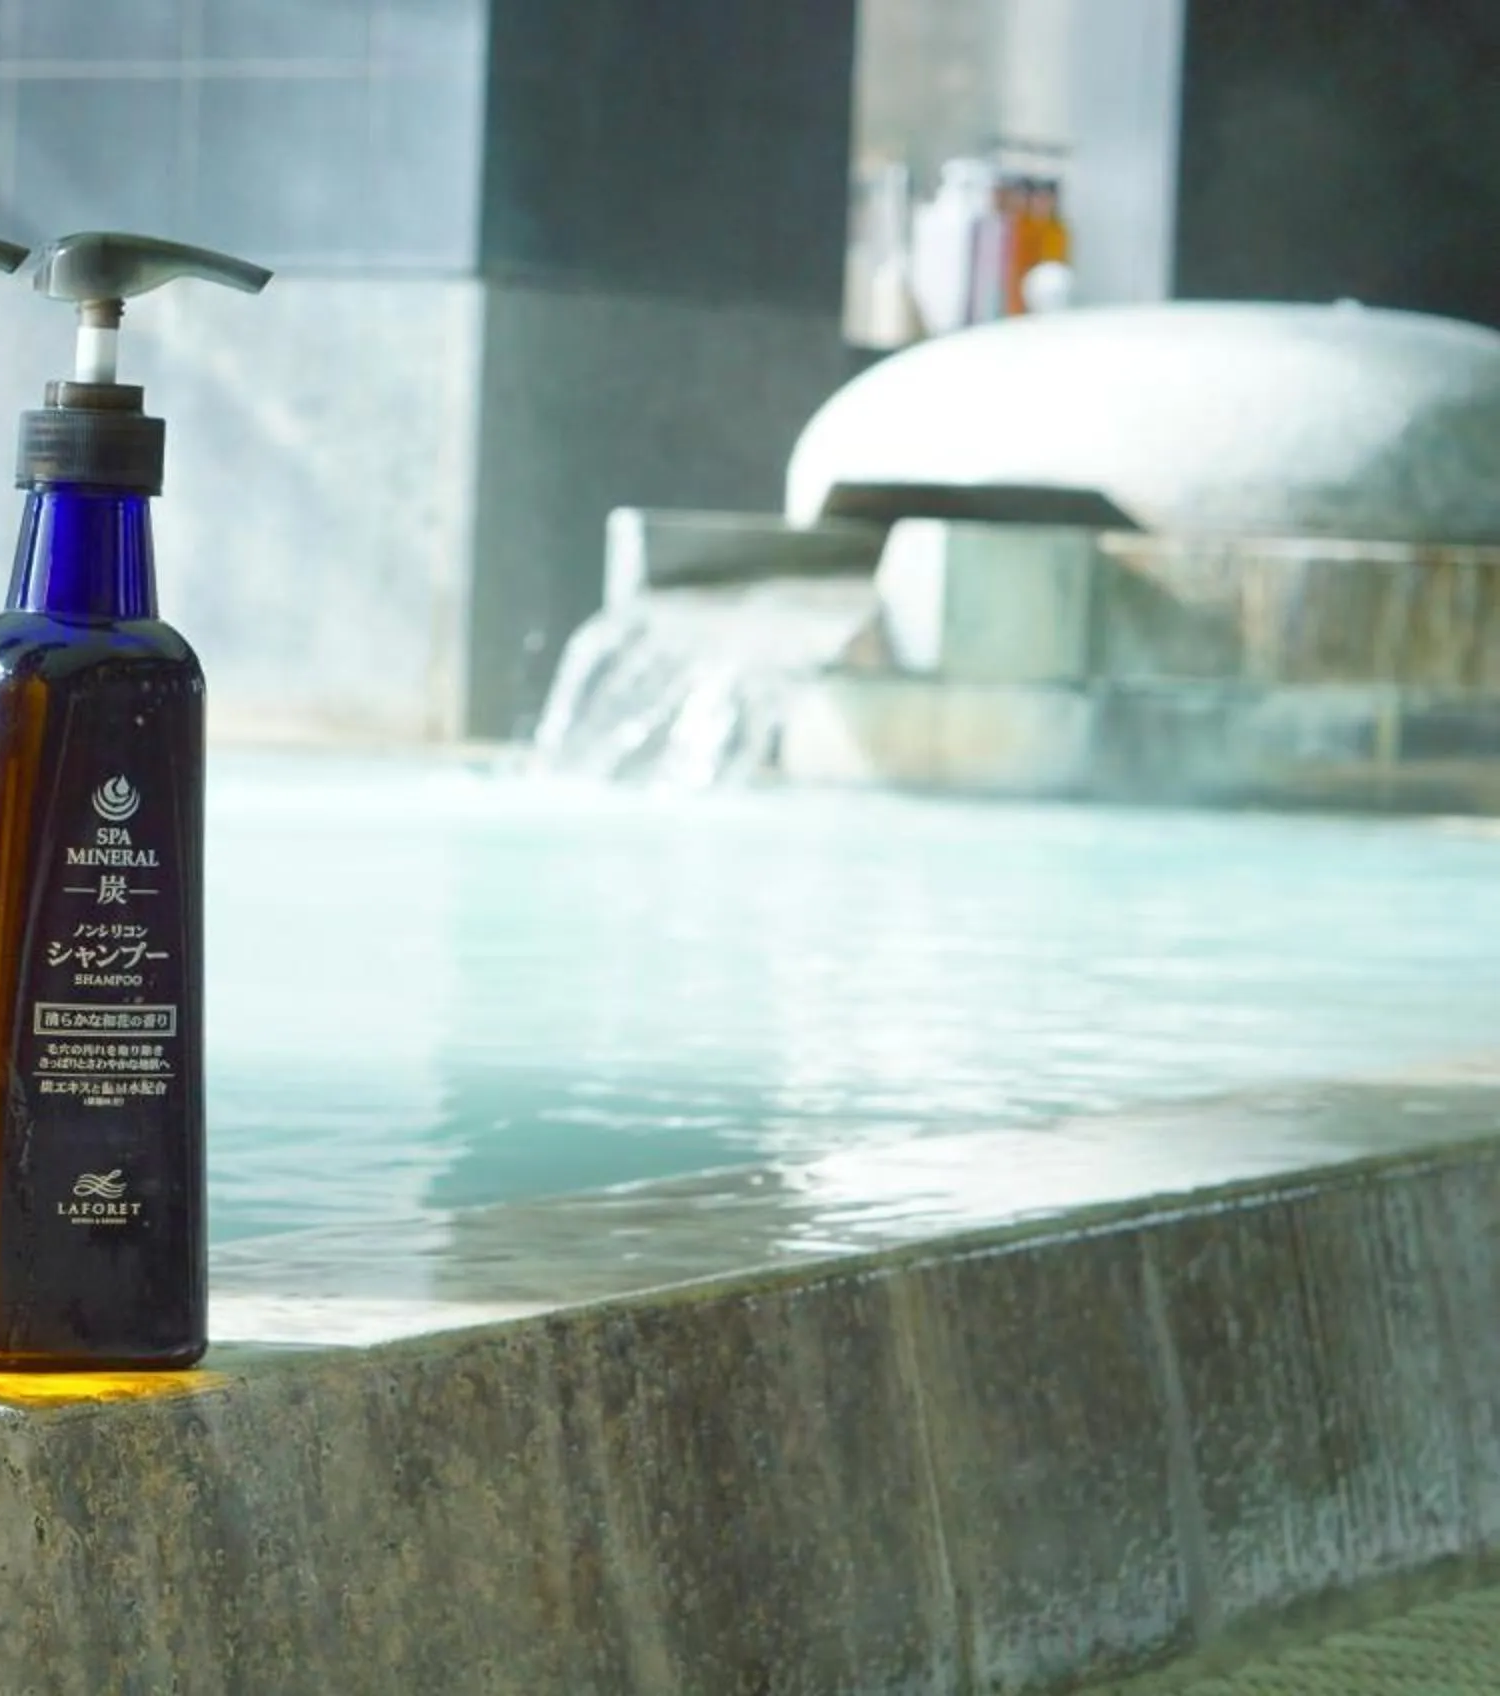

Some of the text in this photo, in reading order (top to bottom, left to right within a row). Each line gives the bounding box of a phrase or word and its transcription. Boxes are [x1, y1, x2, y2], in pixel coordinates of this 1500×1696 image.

[96, 827, 132, 846] SPA
[65, 847, 160, 867] MINERAL
[96, 874, 128, 905] 炭
[73, 923, 148, 939] ノンシリコン
[47, 941, 170, 969] シャンプー
[73, 973, 144, 987] SHAMPOO
[56, 1202, 142, 1216] LAFORET
